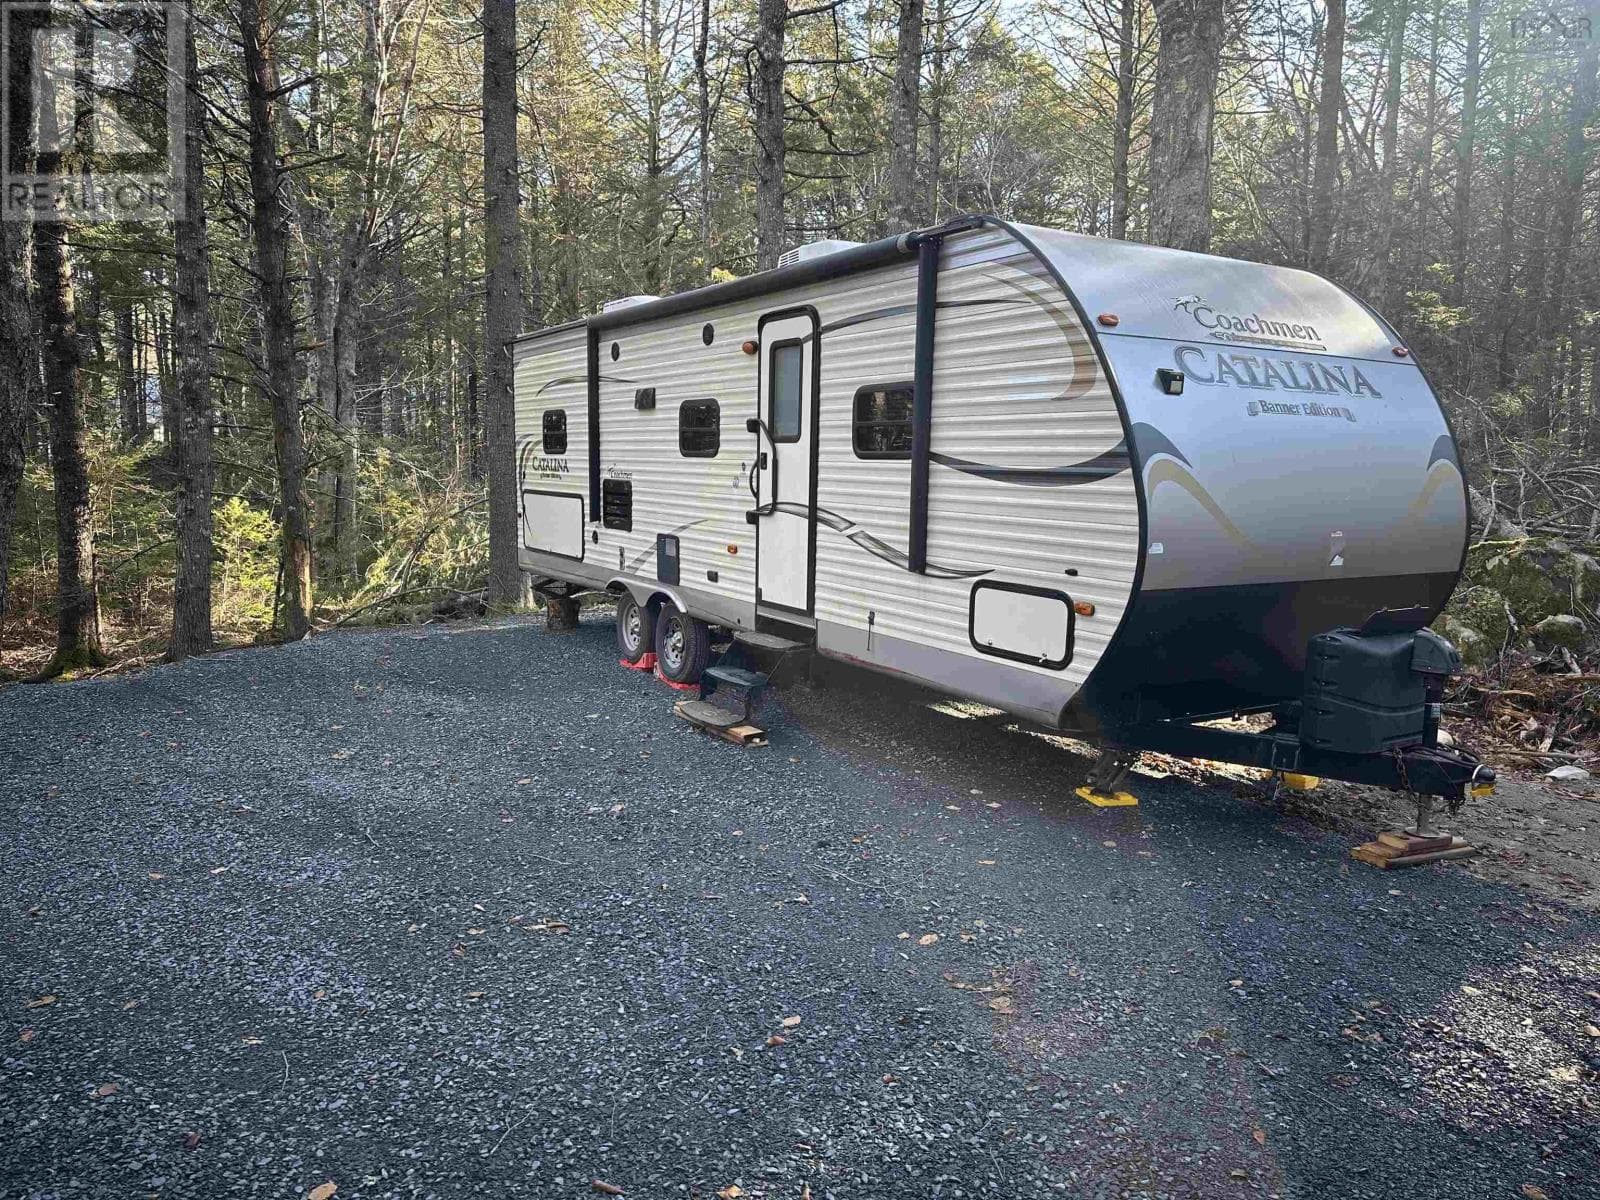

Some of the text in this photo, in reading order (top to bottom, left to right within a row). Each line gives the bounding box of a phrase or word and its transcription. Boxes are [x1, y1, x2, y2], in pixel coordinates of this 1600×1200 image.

[1193, 305, 1322, 341] Coachmen
[1174, 345, 1383, 399] CATALINA
[1258, 399, 1342, 418] Banner Edition
[532, 456, 569, 473] CATALINA
